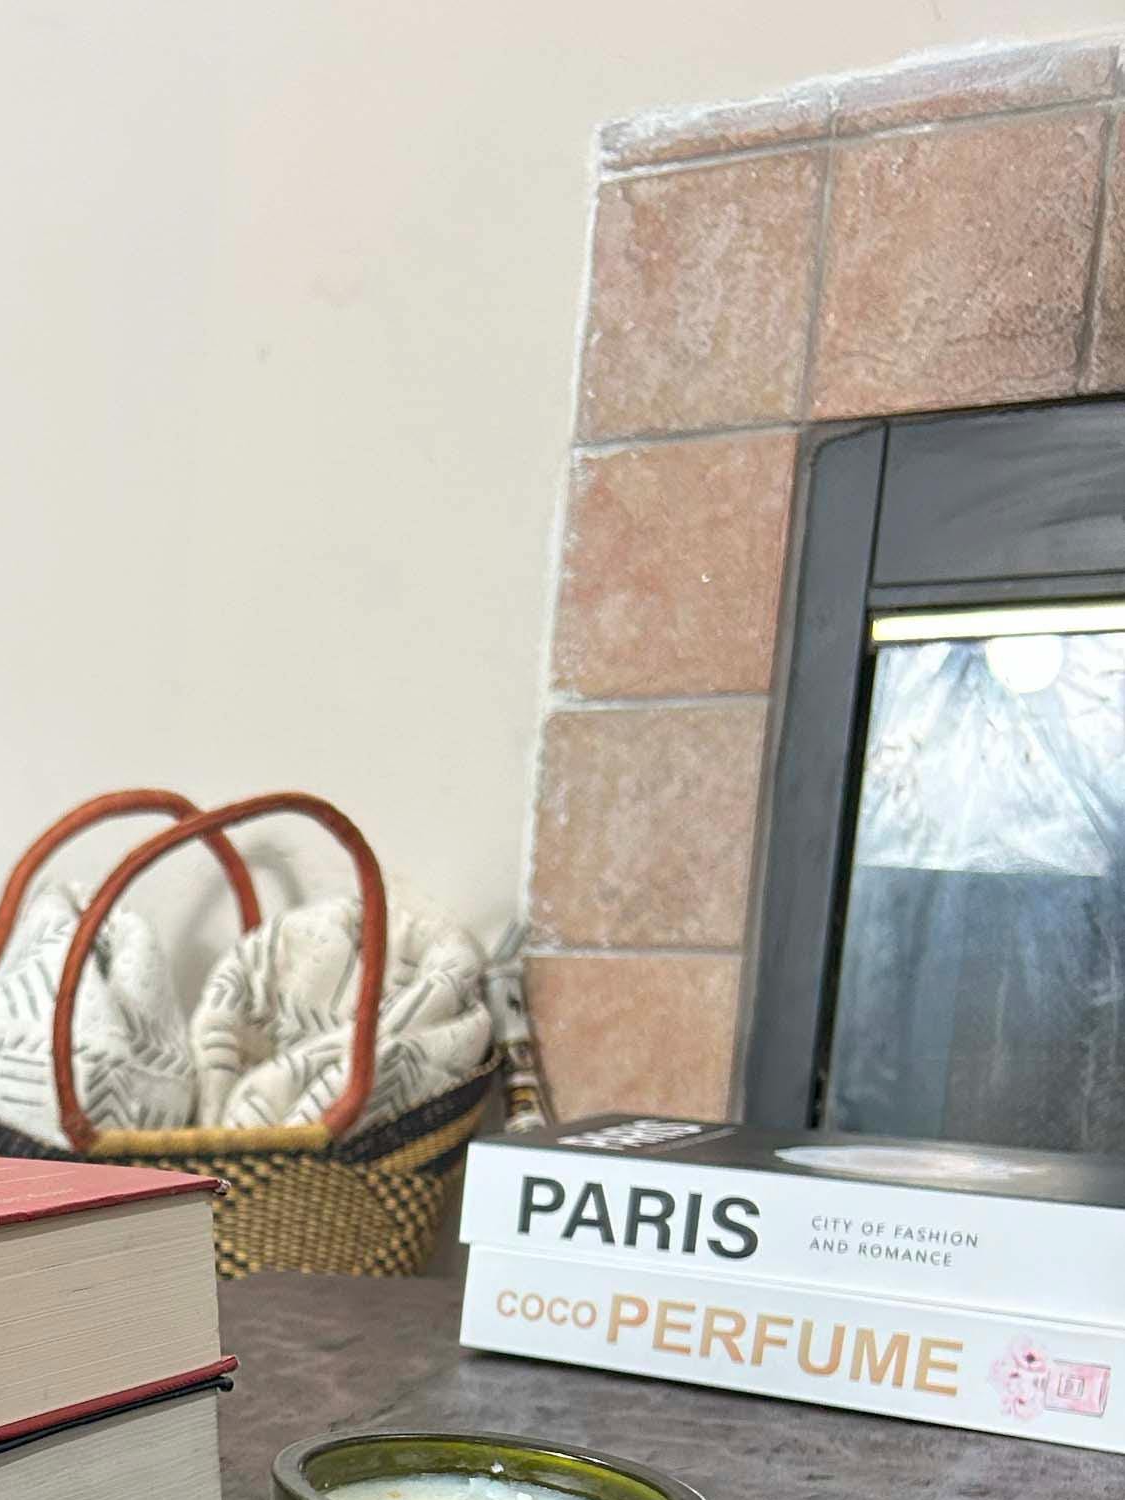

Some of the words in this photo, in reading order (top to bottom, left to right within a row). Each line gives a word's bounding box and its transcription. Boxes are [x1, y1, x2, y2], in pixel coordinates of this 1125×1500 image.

[517, 1174, 761, 1260] PARIS
[811, 1215, 853, 1234] CITY
[861, 1221, 887, 1237] OF
[894, 1224, 979, 1249] FASHION
[809, 1236, 849, 1254] AND
[858, 1242, 953, 1268] ROMANCE
[495, 1289, 597, 1329] COCO
[605, 1293, 964, 1397] PERFUME
